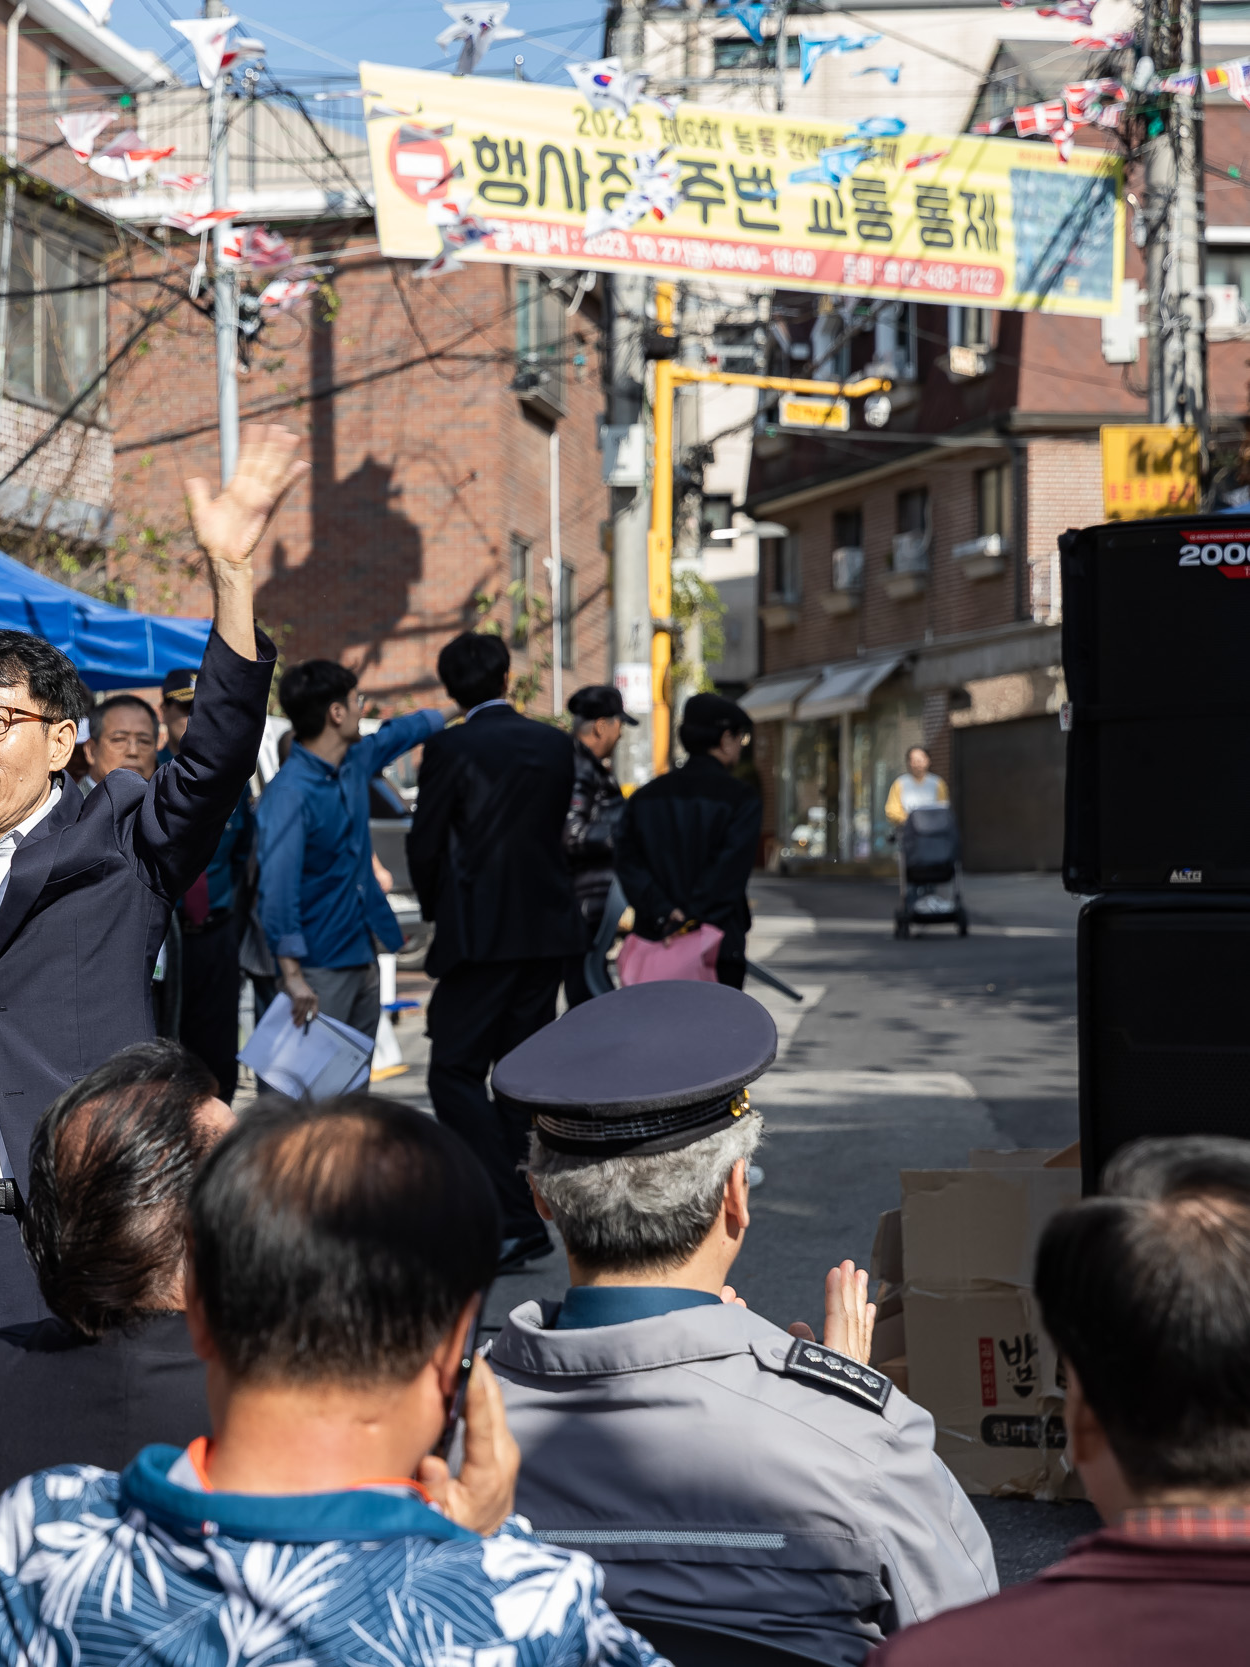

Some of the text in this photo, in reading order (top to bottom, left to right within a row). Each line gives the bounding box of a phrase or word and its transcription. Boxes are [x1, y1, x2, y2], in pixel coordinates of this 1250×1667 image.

[807, 176, 893, 242] 교통
[915, 183, 998, 252] 통제
[1178, 542, 1250, 567] 200
[1170, 869, 1202, 881] ALTO
